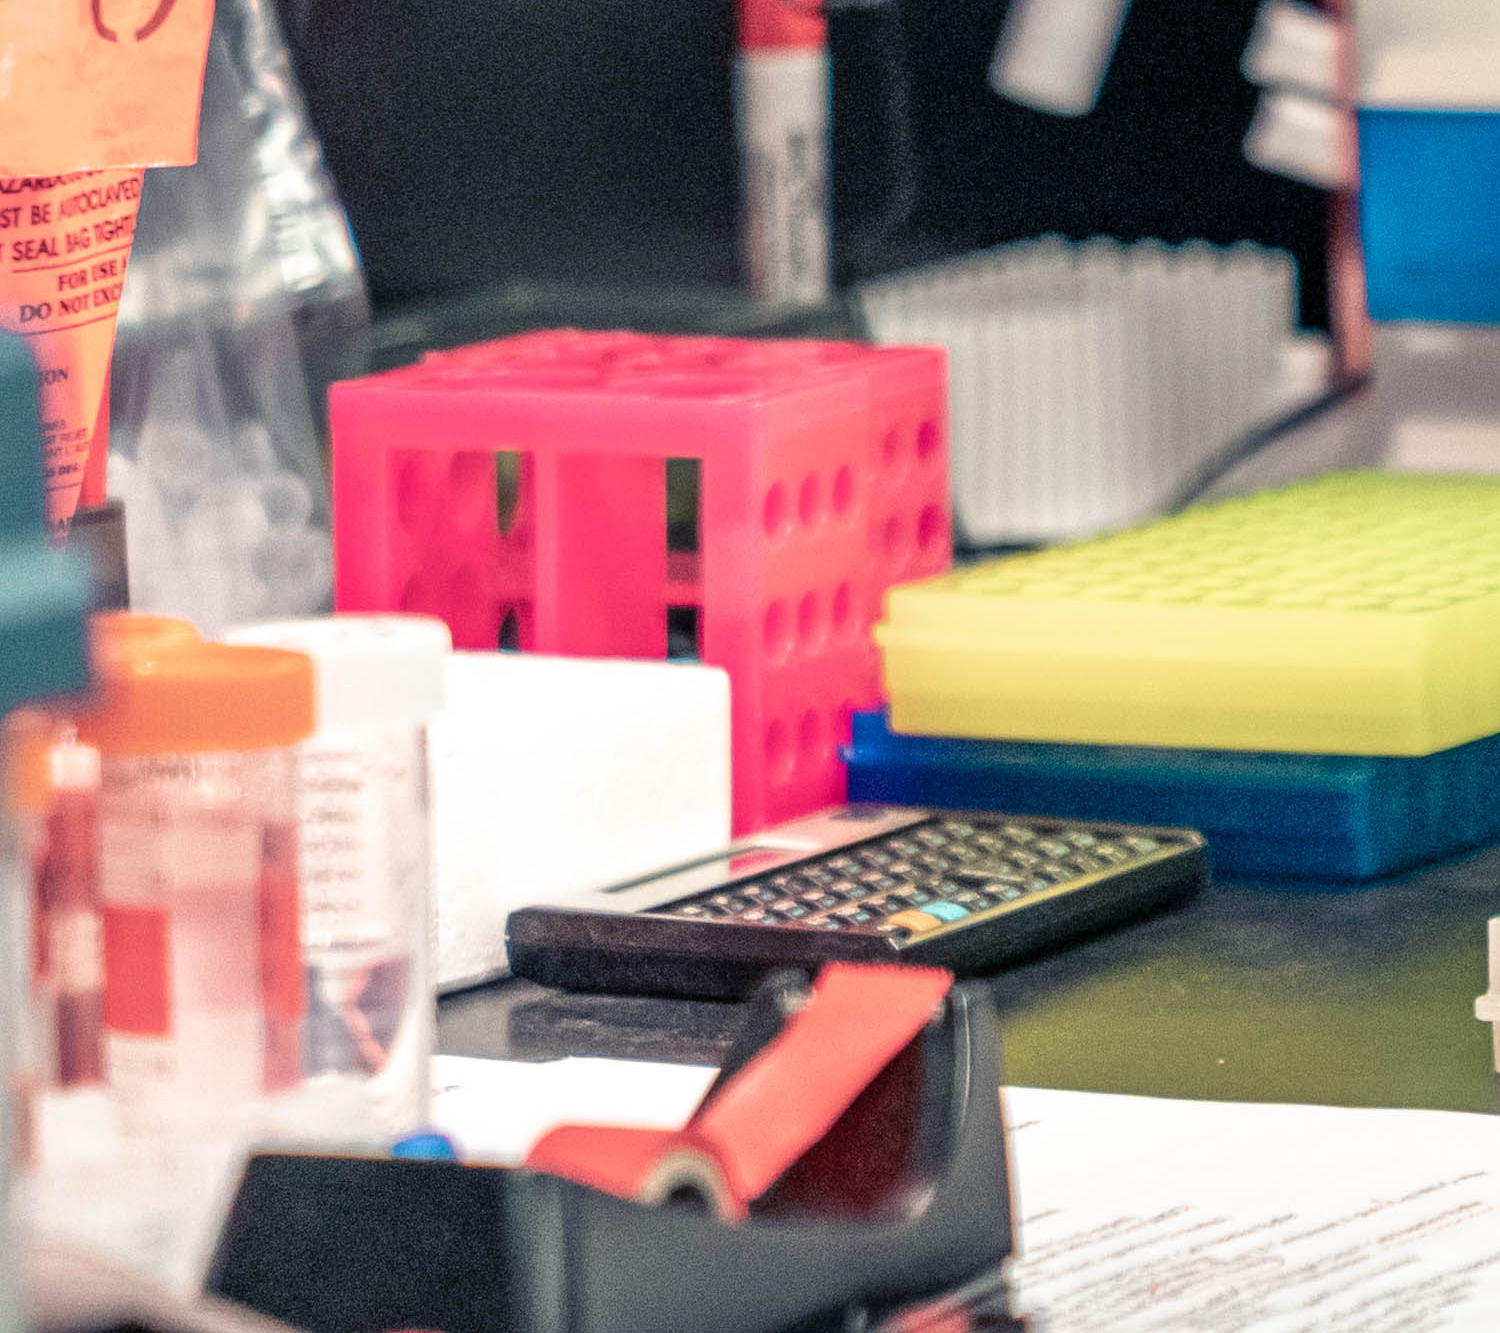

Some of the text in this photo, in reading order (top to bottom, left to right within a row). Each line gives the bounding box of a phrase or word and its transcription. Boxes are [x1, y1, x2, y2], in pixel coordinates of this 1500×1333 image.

[31, 203, 52, 226] BE
[12, 236, 59, 262] SEAL
[65, 226, 91, 255] BAG
[58, 269, 88, 292] FOR
[92, 259, 118, 282] USE
[19, 301, 51, 323] DO
[58, 293, 90, 317] NOT
